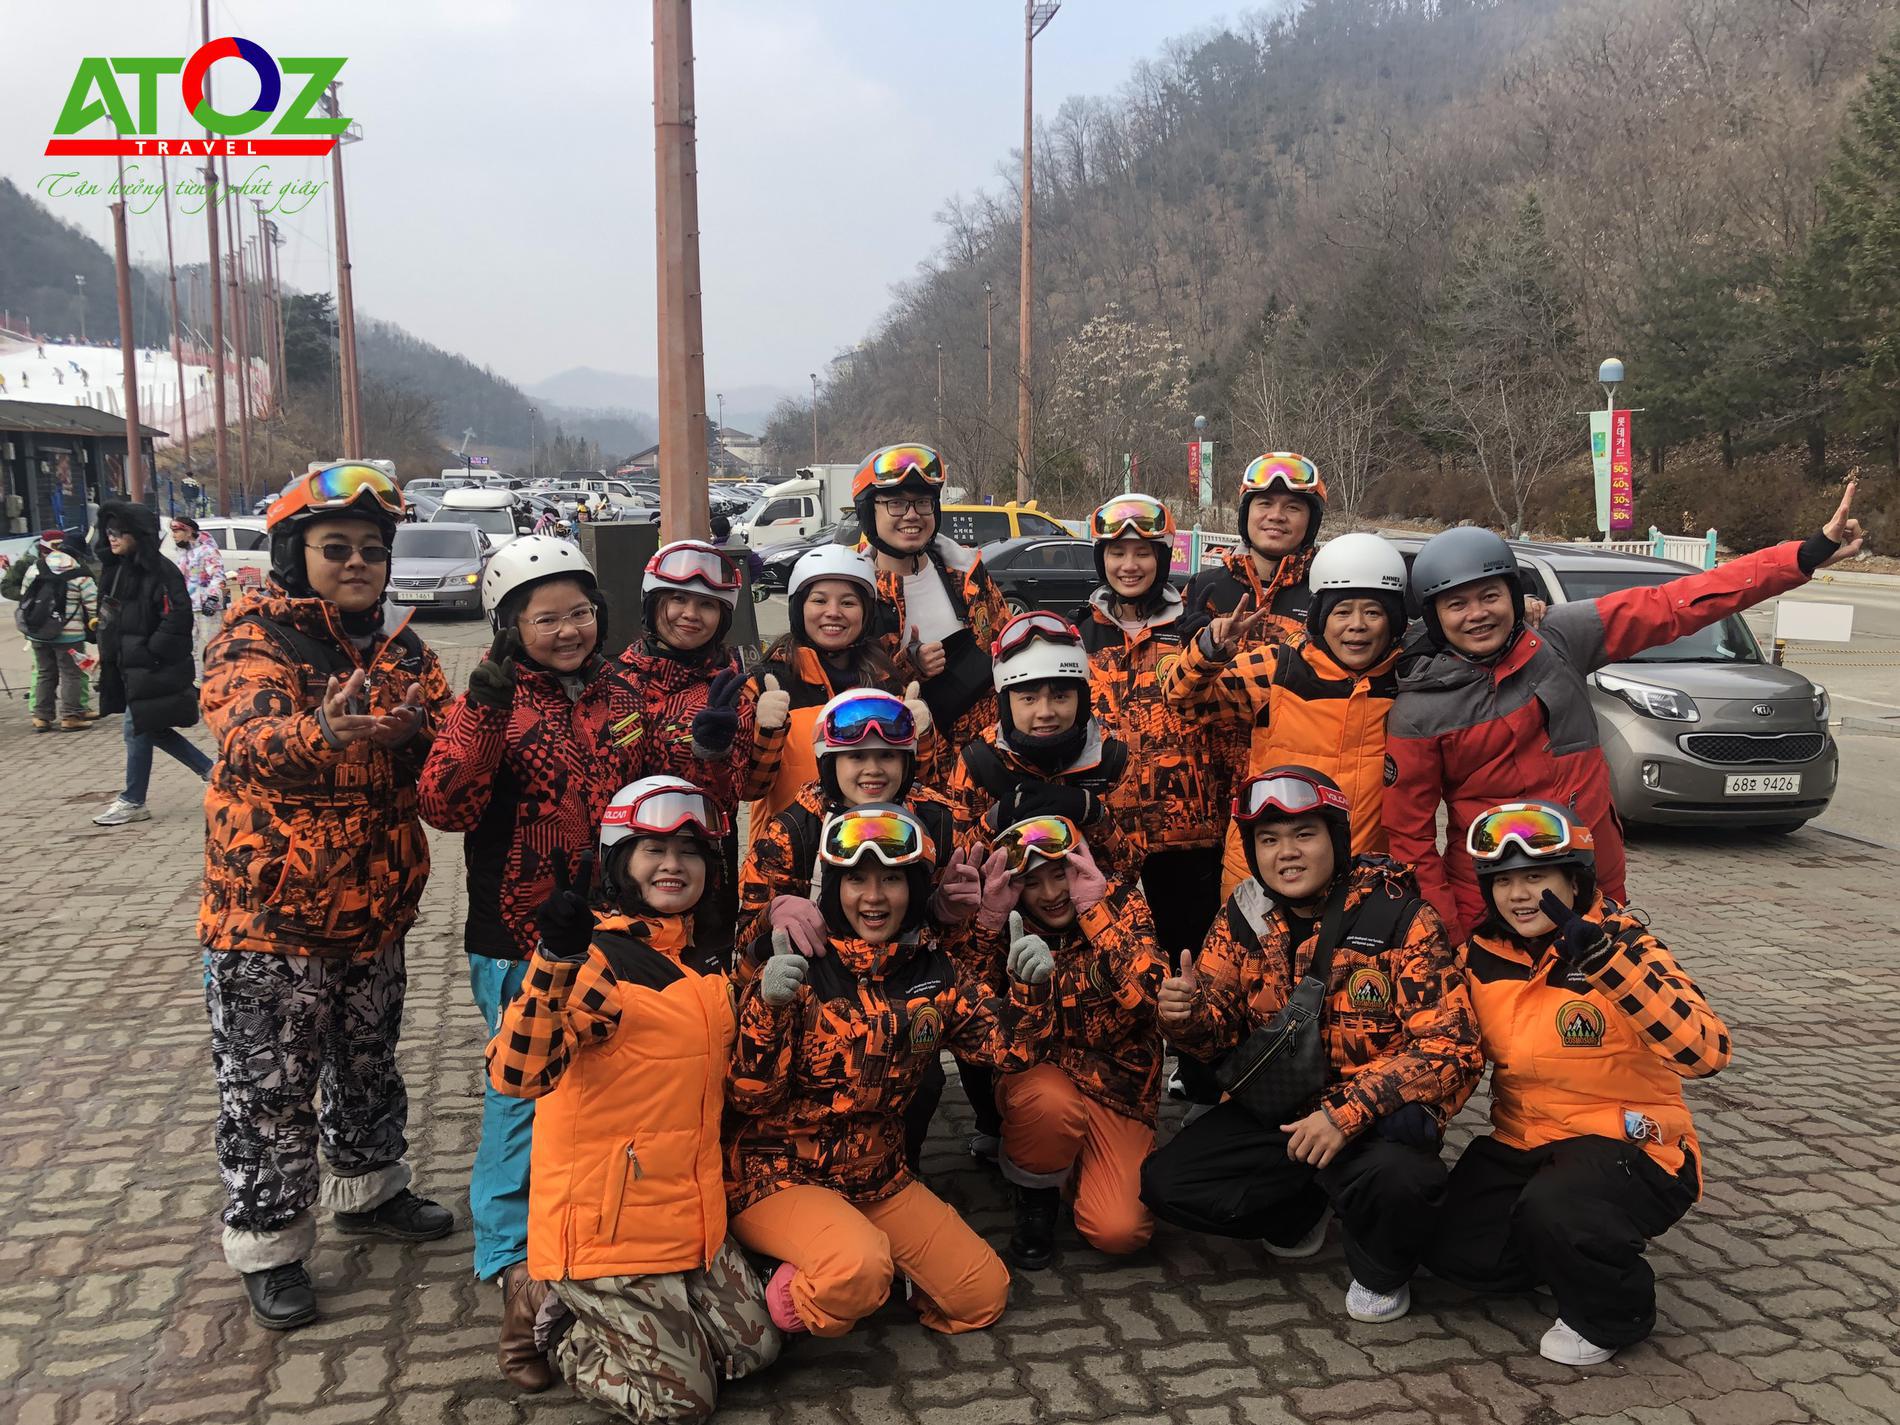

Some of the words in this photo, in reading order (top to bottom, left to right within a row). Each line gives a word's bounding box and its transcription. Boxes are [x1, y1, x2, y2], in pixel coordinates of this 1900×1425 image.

[1616, 416, 1625, 457] 롯데카드
[1613, 465, 1629, 473] 50%
[1613, 480, 1629, 488] 40%
[1613, 496, 1630, 504] 30%
[1613, 511, 1630, 520] 50%
[1756, 705, 1771, 715] KIA
[1763, 777, 1793, 792] 9426
